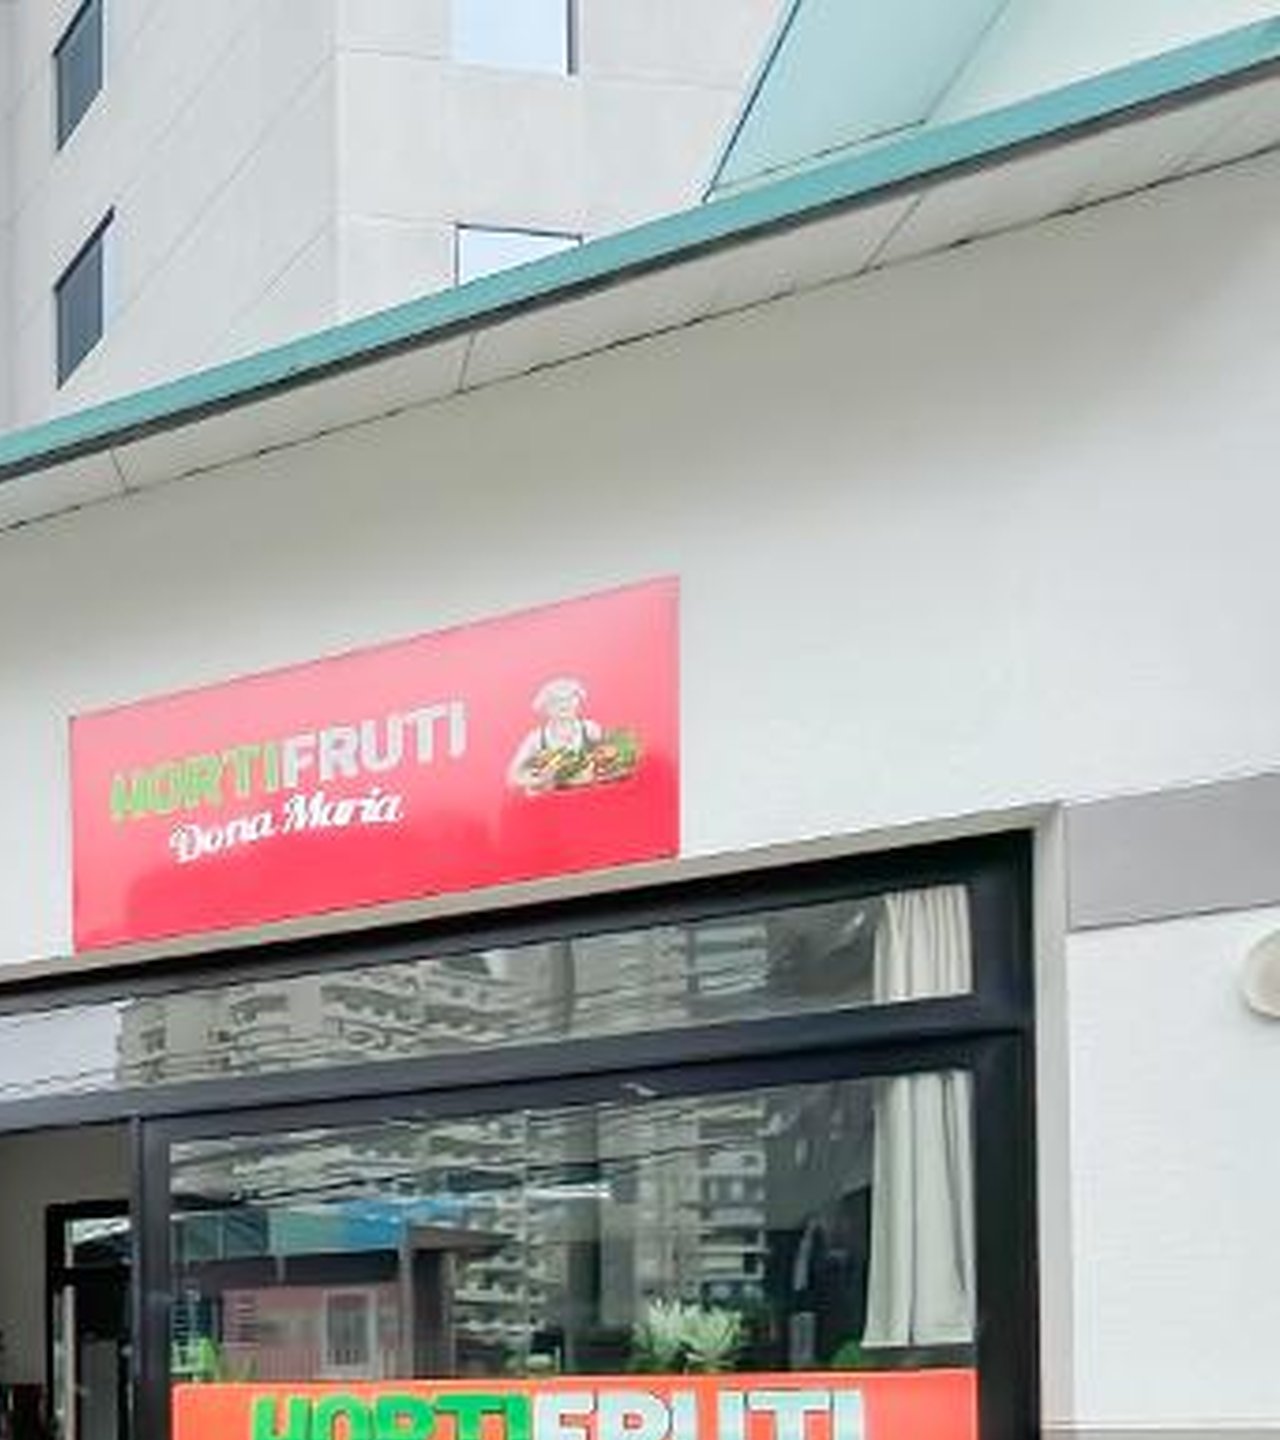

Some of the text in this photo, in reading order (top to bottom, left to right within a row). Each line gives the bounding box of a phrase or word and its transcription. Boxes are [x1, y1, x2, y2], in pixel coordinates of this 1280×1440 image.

[111, 701, 469, 821] HORTIFRUTI
[169, 790, 403, 865] Dona Maria
